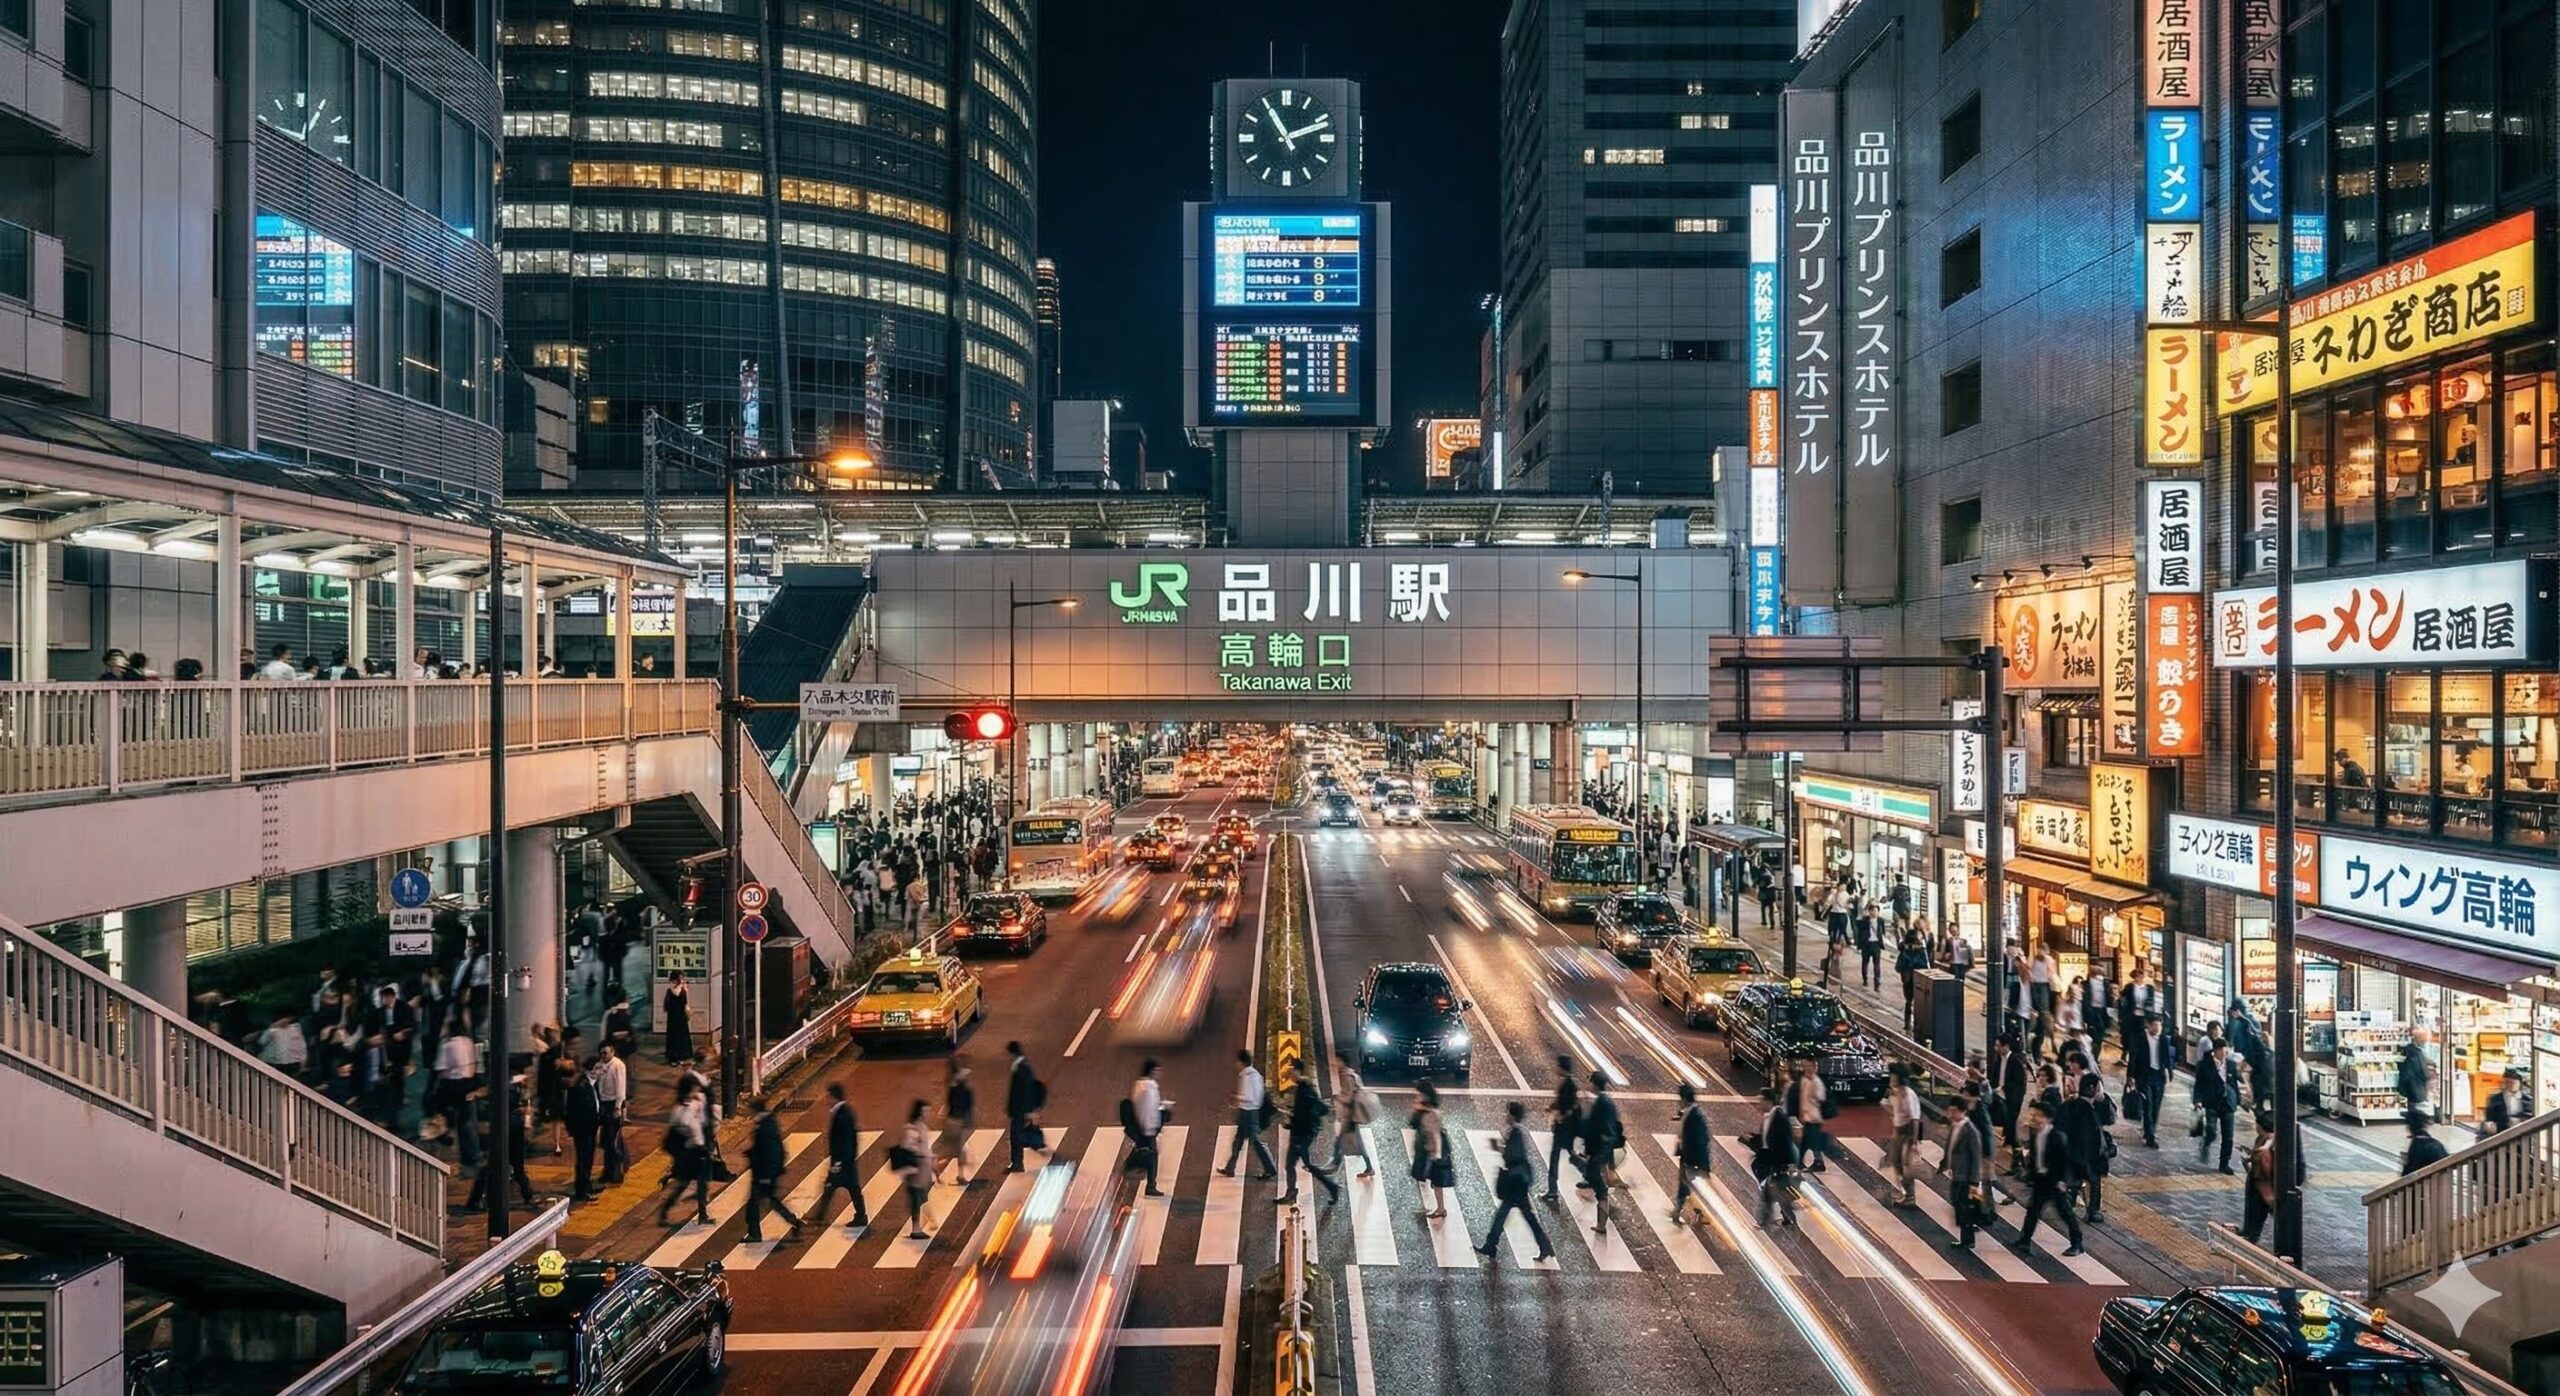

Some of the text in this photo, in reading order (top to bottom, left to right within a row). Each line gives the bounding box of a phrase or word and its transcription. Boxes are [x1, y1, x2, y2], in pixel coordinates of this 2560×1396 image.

[2156, 0, 2191, 98] 居酒屋
[2160, 116, 2188, 215] ラーメン
[1794, 139, 1831, 474] 品川プリンスホテル
[1855, 132, 1891, 467] 品川プリンスホテル
[2158, 335, 2190, 453] ラーメン
[2159, 489, 2190, 587] 居酒屋
[1110, 563, 1189, 608] JR
[1218, 562, 1451, 623] 品川駅
[2258, 588, 2404, 656] ラーメン
[2412, 602, 2515, 651] 居酒屋
[1219, 632, 1351, 668] 高輪口
[2051, 610, 2098, 651] ラーメン
[1219, 673, 1352, 691] Takanawa Exit
[744, 890, 761, 903] 30
[2345, 854, 2537, 938] ウィング高輪
